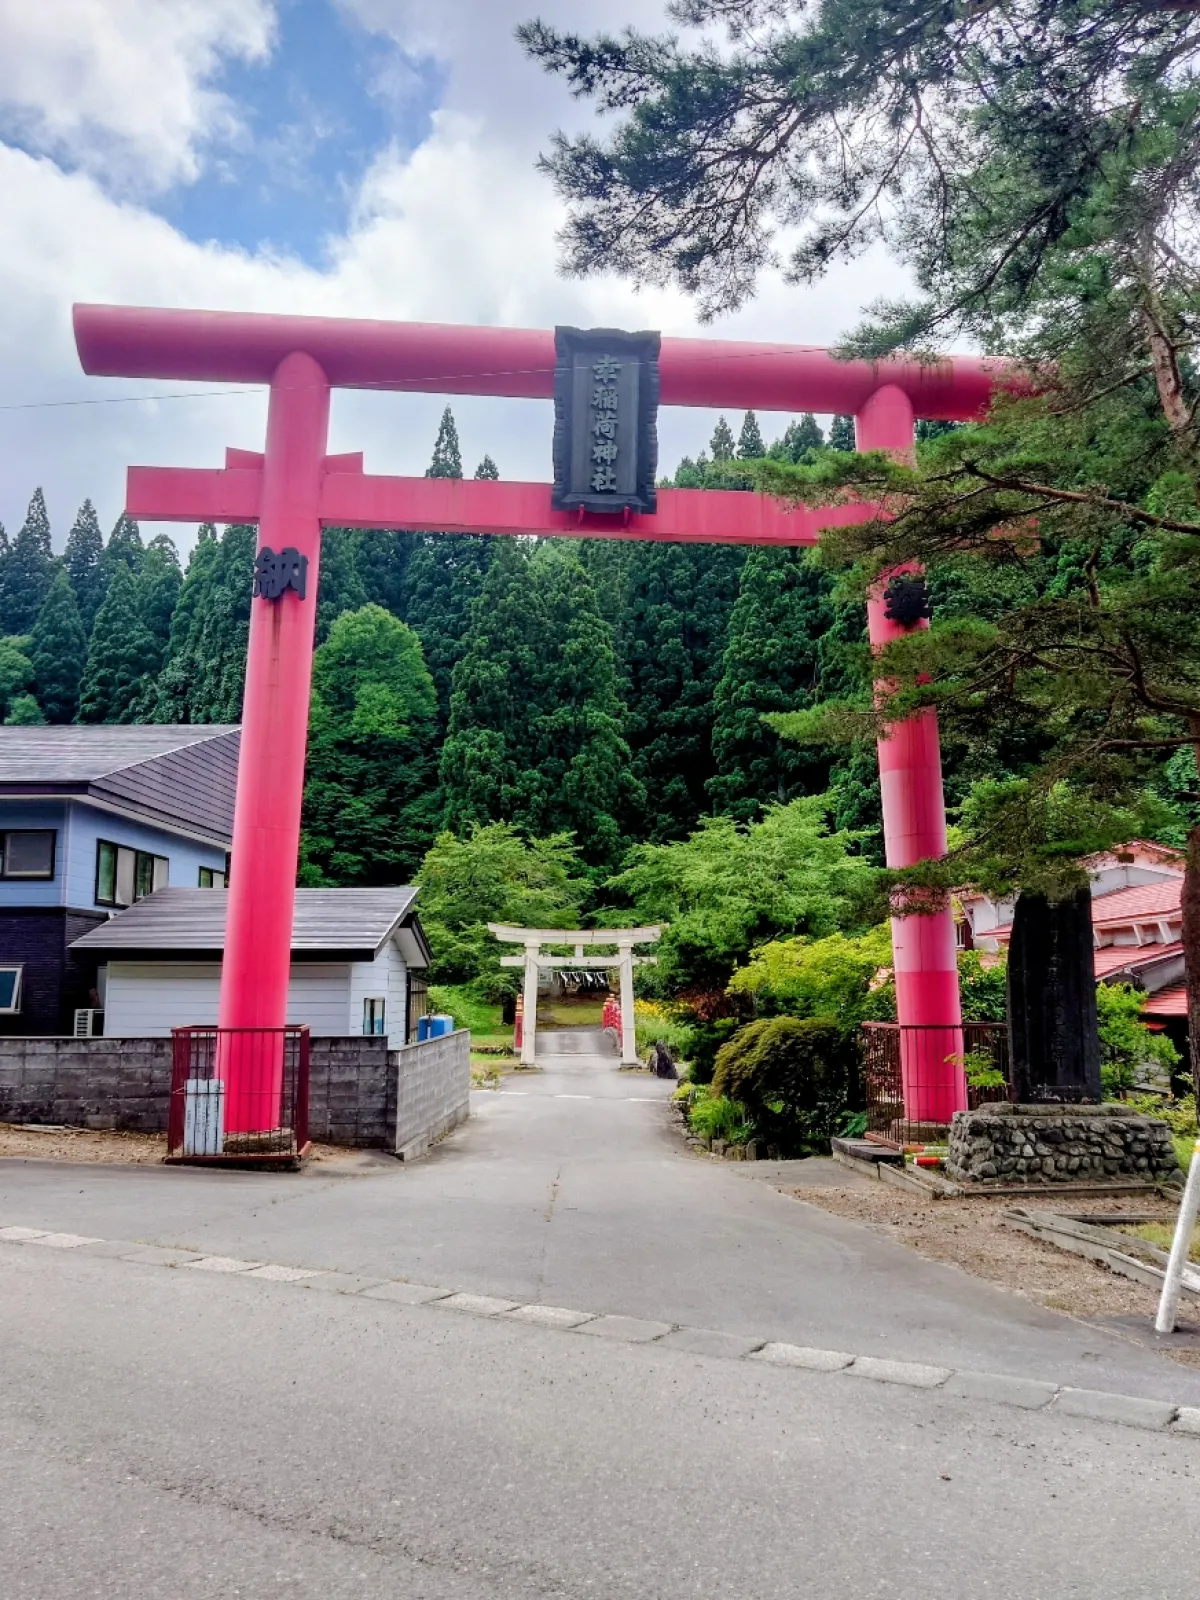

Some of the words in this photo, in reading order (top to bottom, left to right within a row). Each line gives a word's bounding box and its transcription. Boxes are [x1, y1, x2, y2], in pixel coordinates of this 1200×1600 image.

[590, 353, 623, 492] 幸稲荷神社
